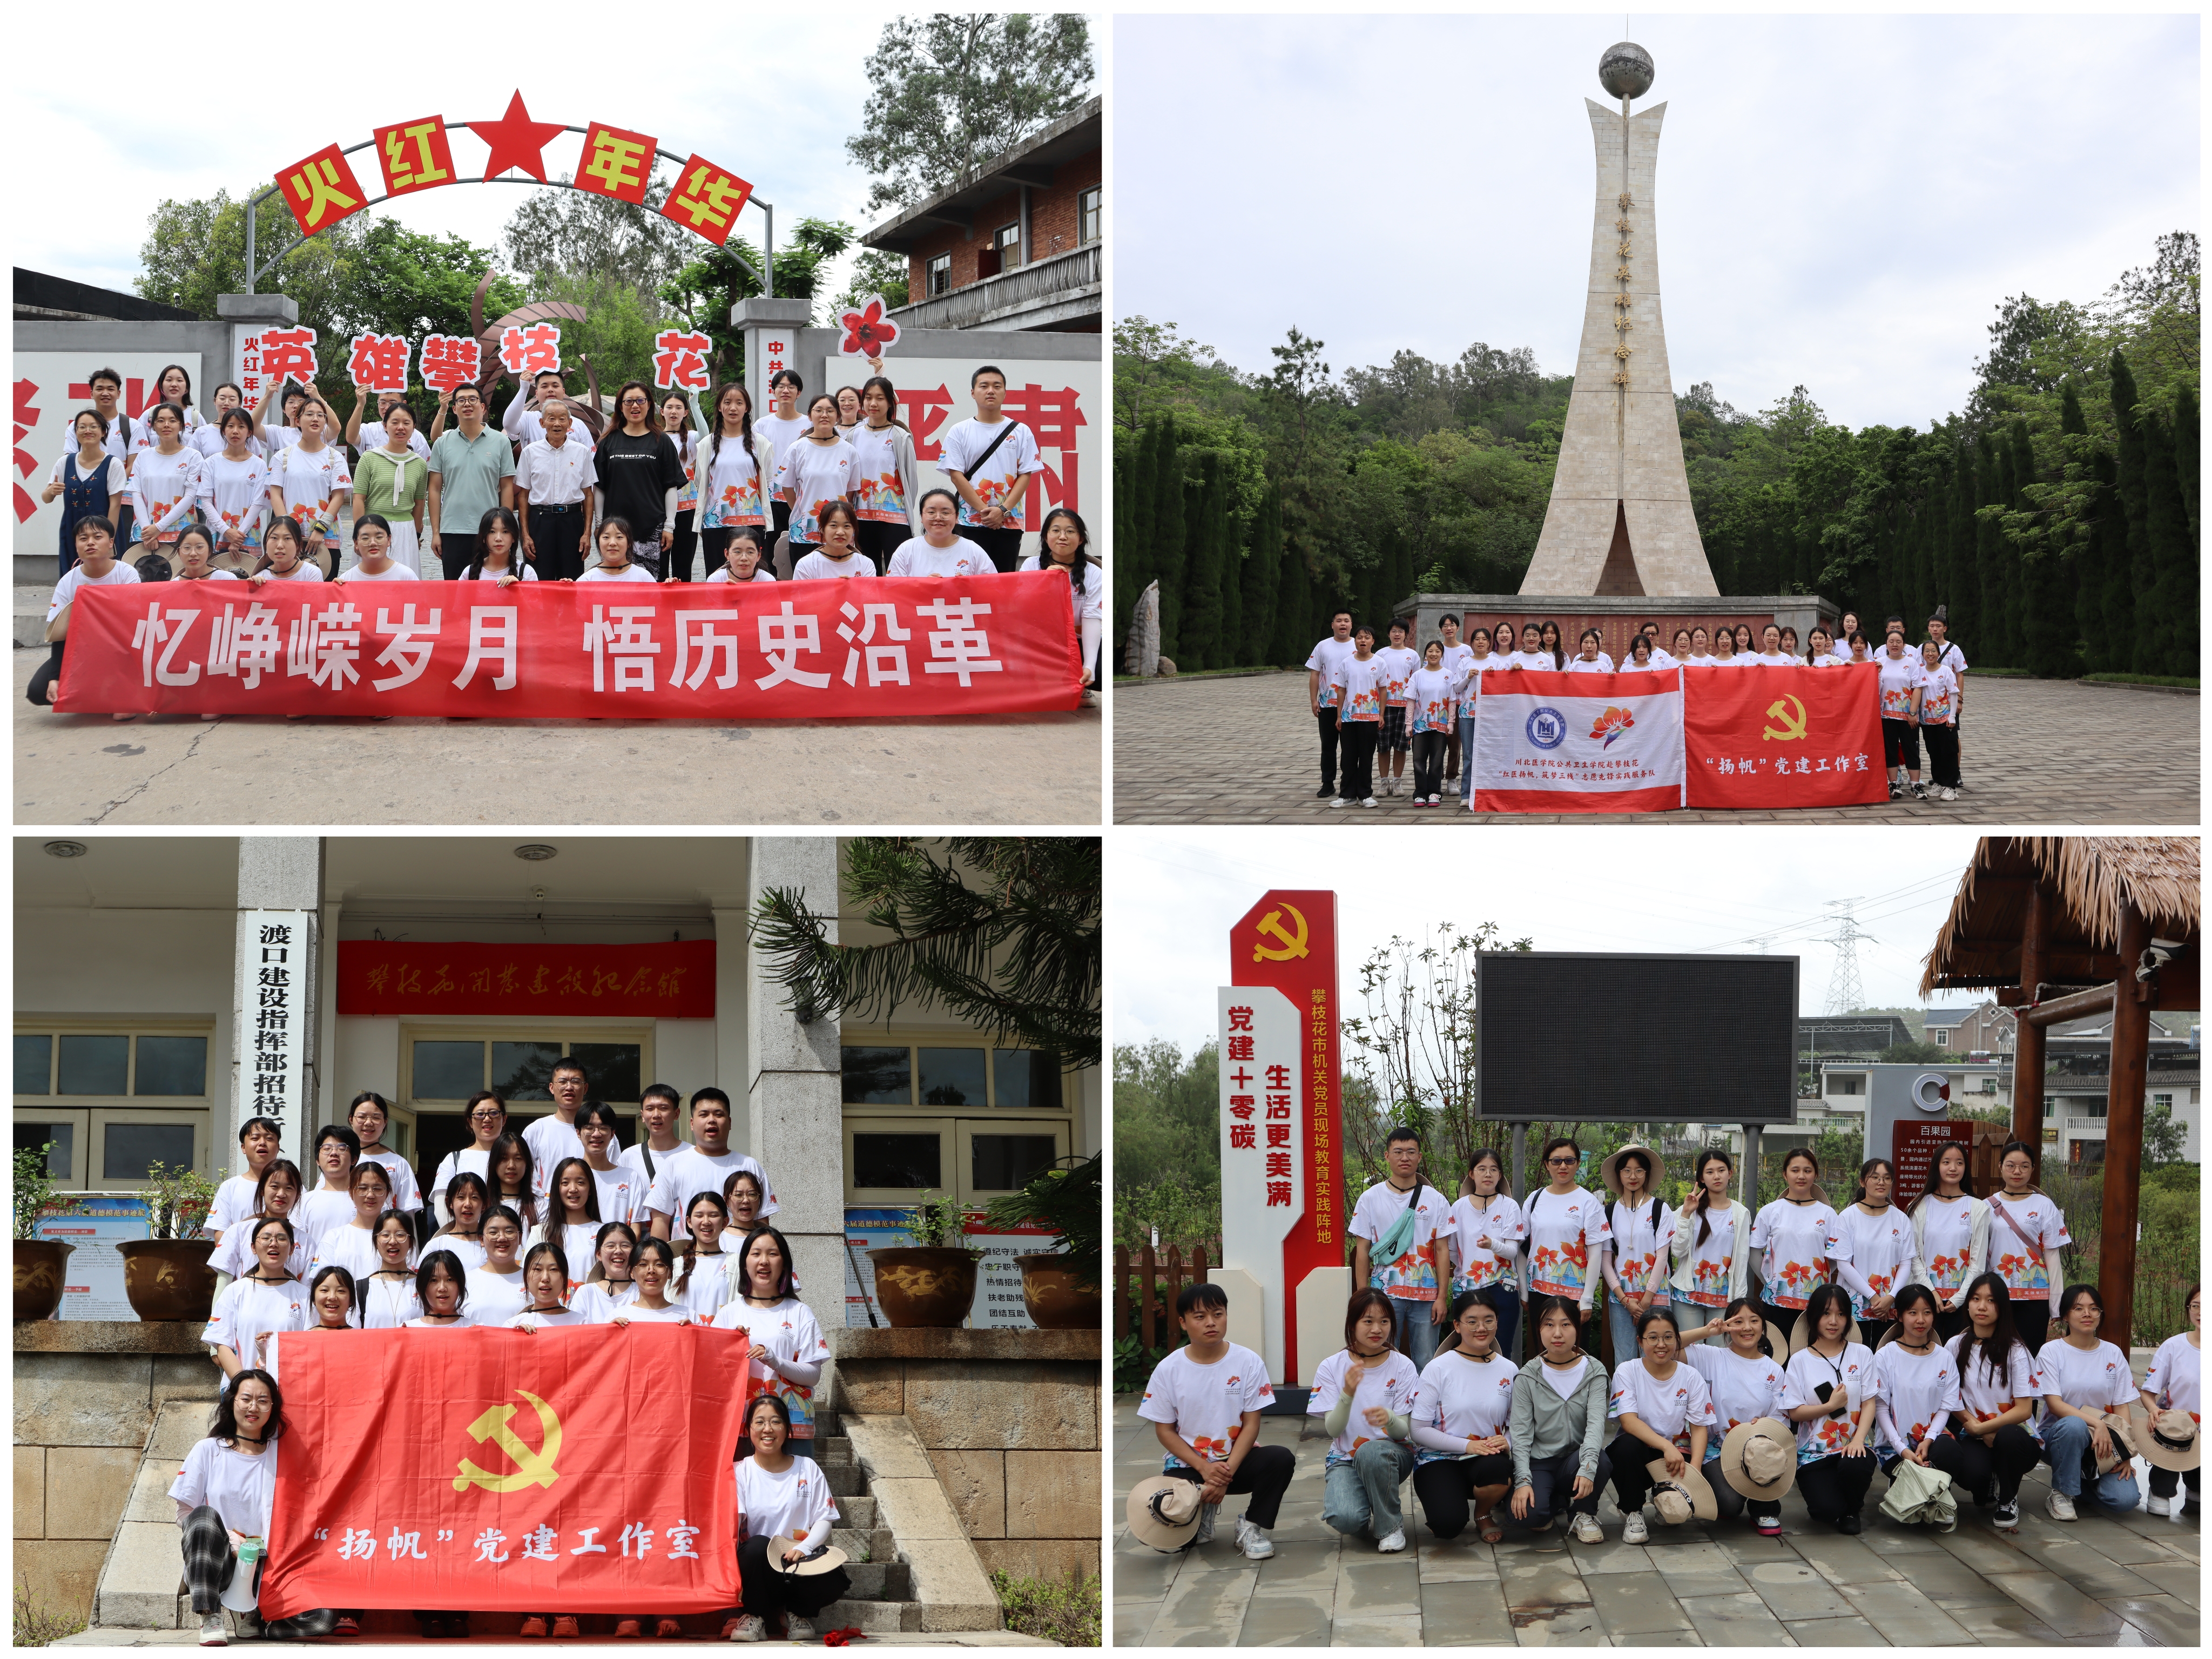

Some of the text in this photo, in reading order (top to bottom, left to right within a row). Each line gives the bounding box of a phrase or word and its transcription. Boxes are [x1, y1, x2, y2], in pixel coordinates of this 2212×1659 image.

[131, 597, 1002, 692] 忆峥嵘岁月 悟历史沿革
[1515, 758, 1639, 768] 川北医学院公共卫生学院赴攀枝花
[1311, 988, 1332, 1244] 攀枝花市机关党员现场教育实践阵地
[1265, 1064, 1292, 1207] 生活更美满
[1920, 1126, 1951, 1137] 百果园
[987, 1278, 1022, 1286] 热情招待
[988, 1293, 1024, 1302] 扶老助残
[989, 1309, 1026, 1318] 团结互助
[314, 1519, 700, 1562] “扬帆”党建工作室
